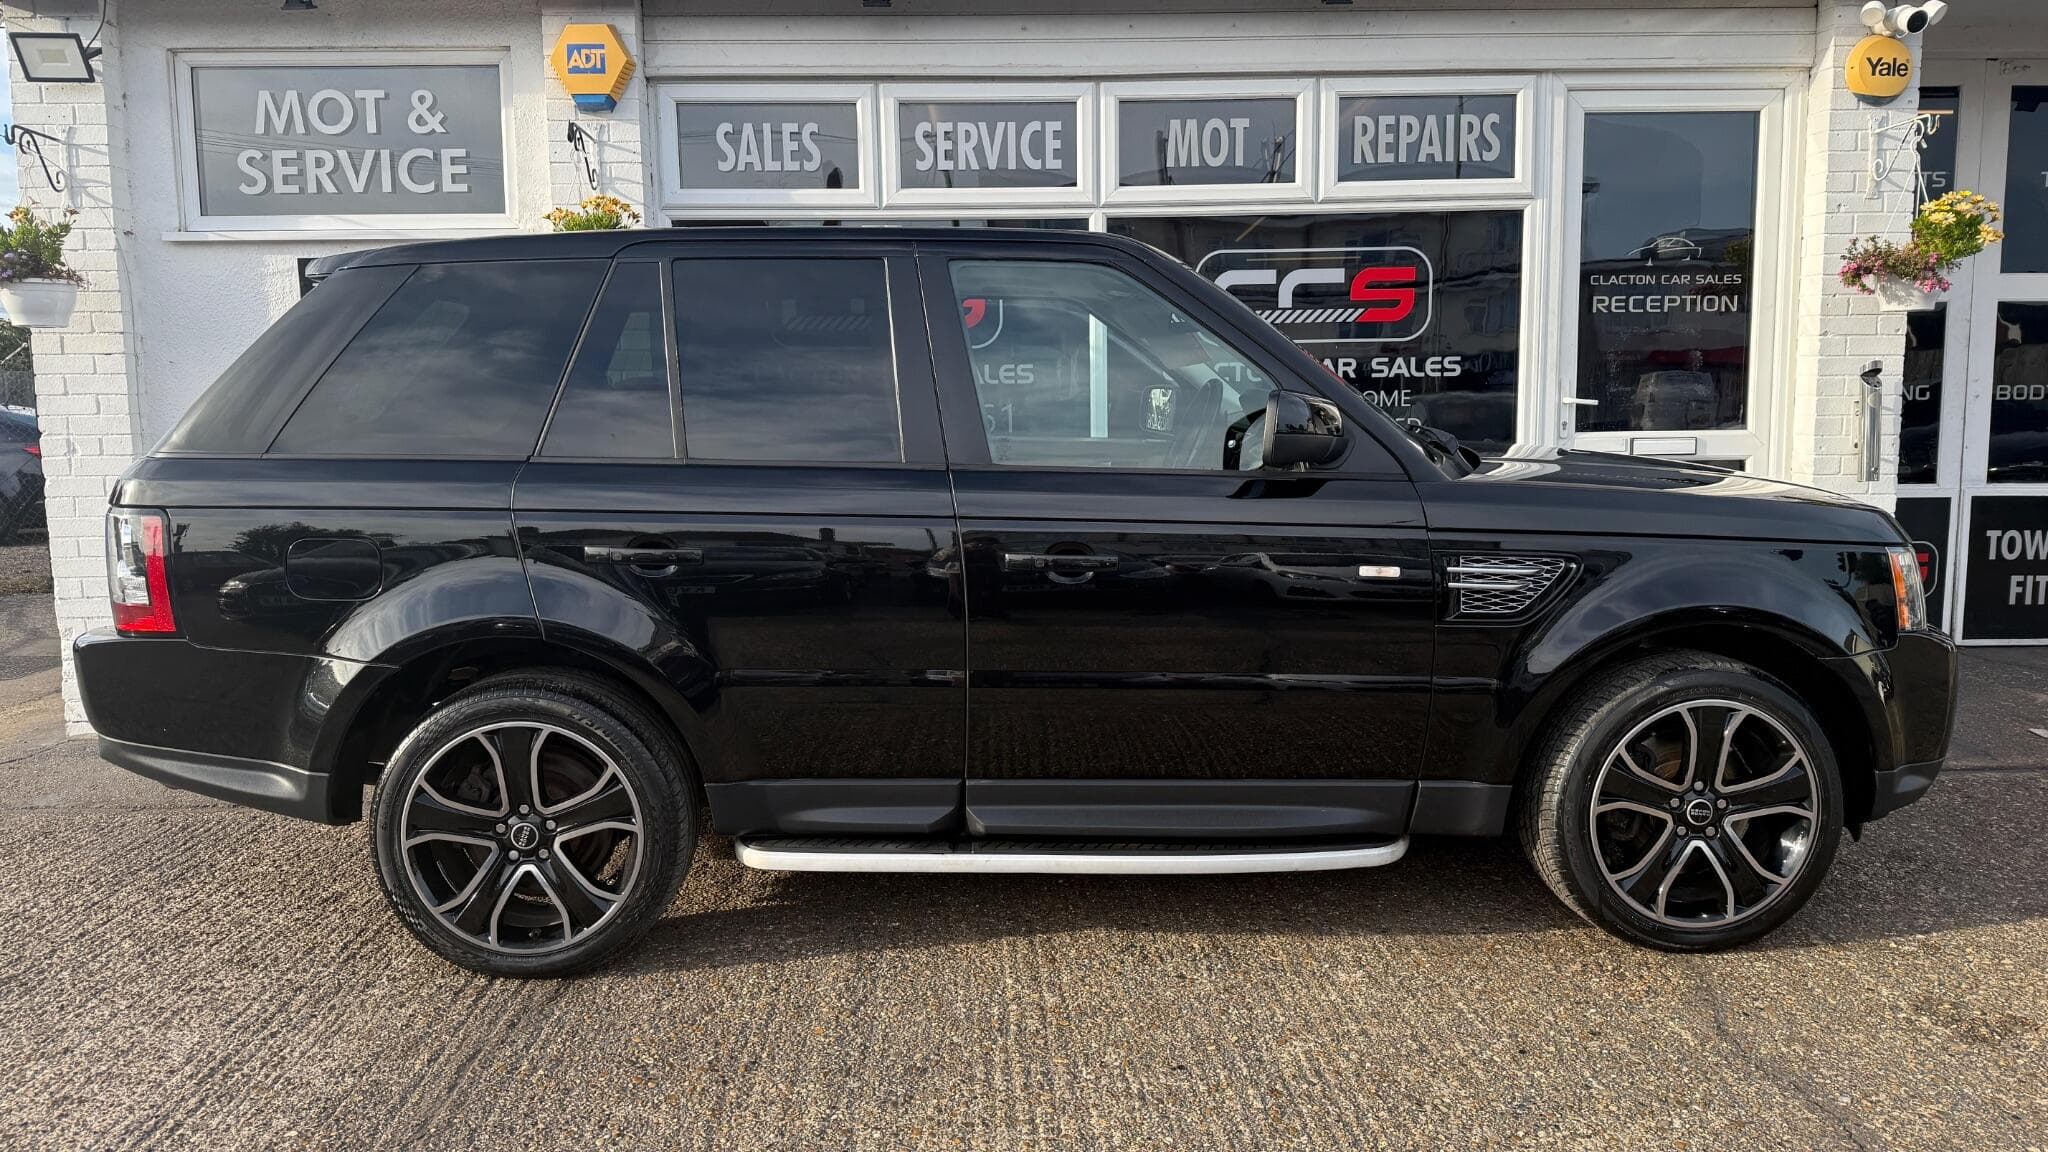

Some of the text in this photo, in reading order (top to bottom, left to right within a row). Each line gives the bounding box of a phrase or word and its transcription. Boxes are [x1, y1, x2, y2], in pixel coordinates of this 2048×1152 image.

[568, 49, 605, 68] ADT
[1866, 57, 1909, 77] Yale
[255, 89, 448, 134] MOT &
[716, 122, 822, 172] SALES
[914, 120, 1063, 171] SERVICE
[1165, 118, 1250, 168] MOT
[1353, 113, 1501, 165] REPAIRS
[237, 148, 471, 195] SERVICE
[1590, 274, 1743, 285] CLACTON CAR SALES
[1592, 295, 1738, 313] RECEPTION
[1371, 356, 1462, 378] SALES
[1996, 384, 2048, 400] BOD
